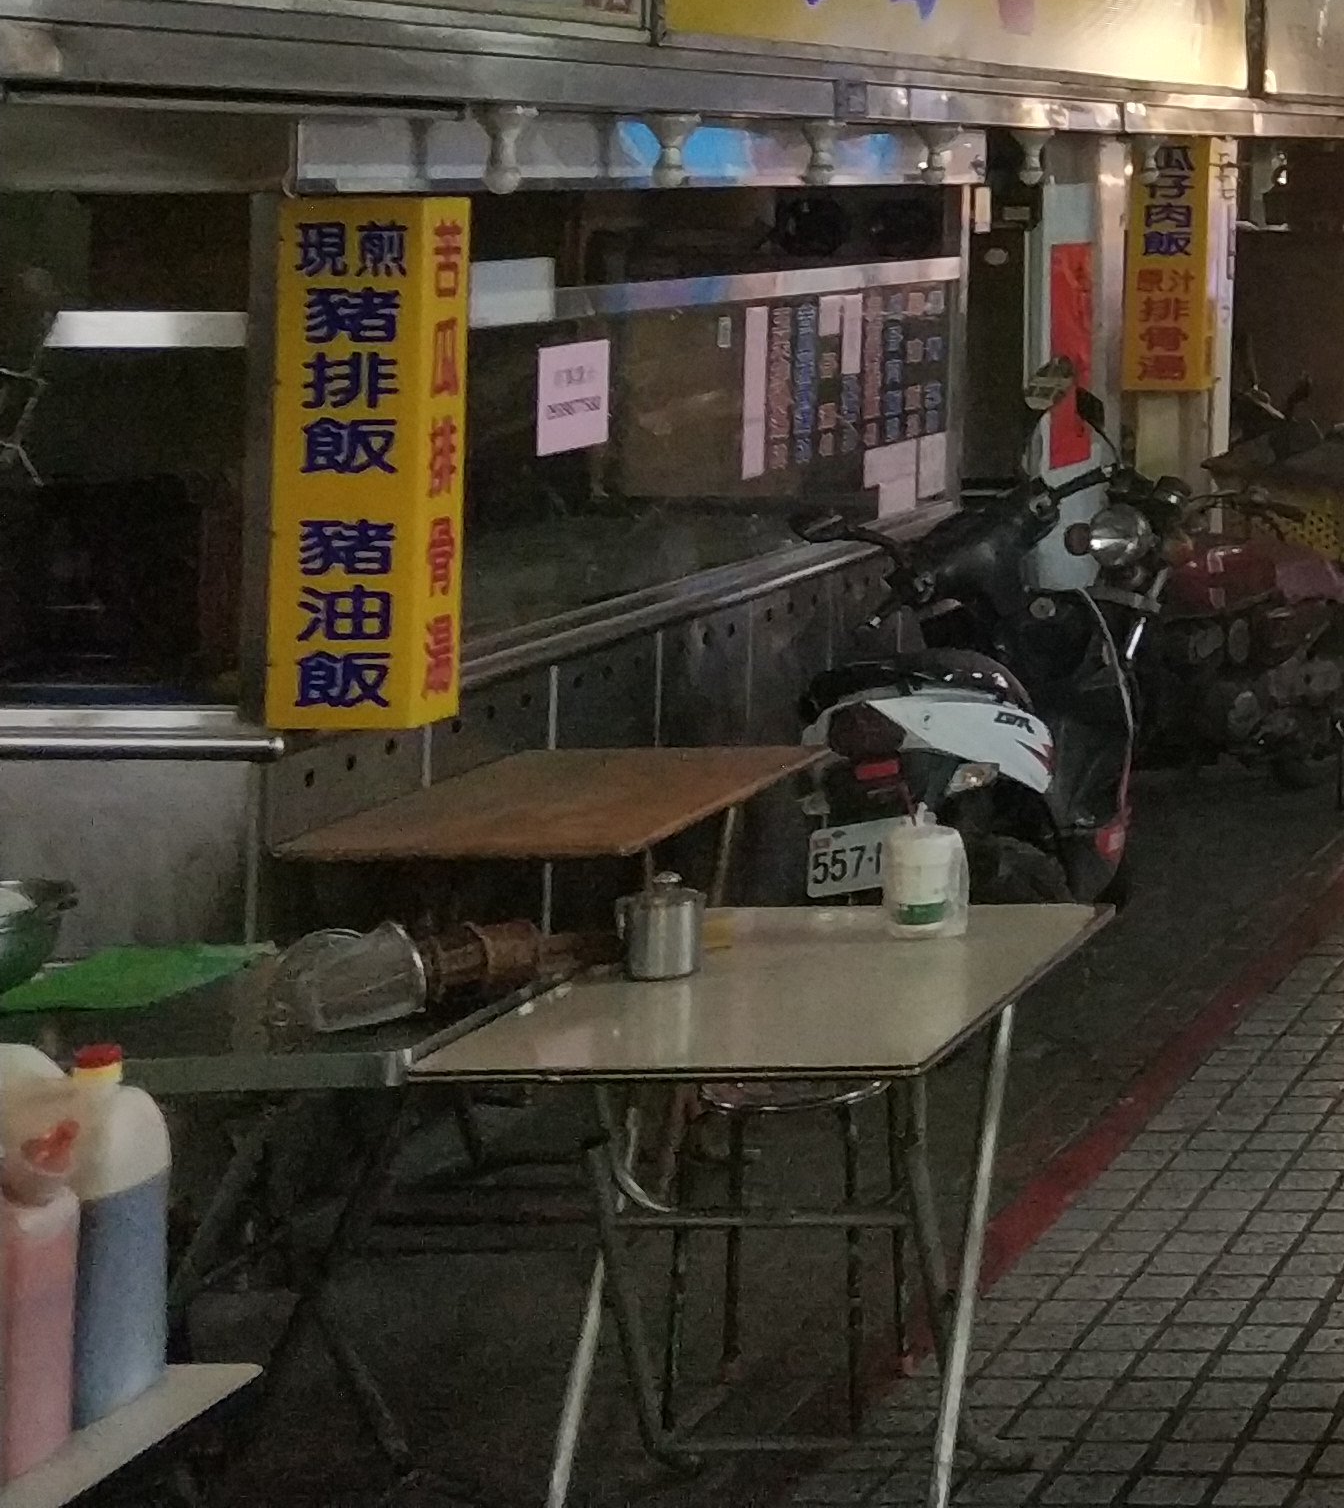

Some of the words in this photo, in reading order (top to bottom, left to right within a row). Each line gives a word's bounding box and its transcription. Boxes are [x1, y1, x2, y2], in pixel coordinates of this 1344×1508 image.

[294, 220, 408, 278] 現煎
[300, 286, 401, 476] 豬排飯
[293, 519, 396, 709] 豬油飯
